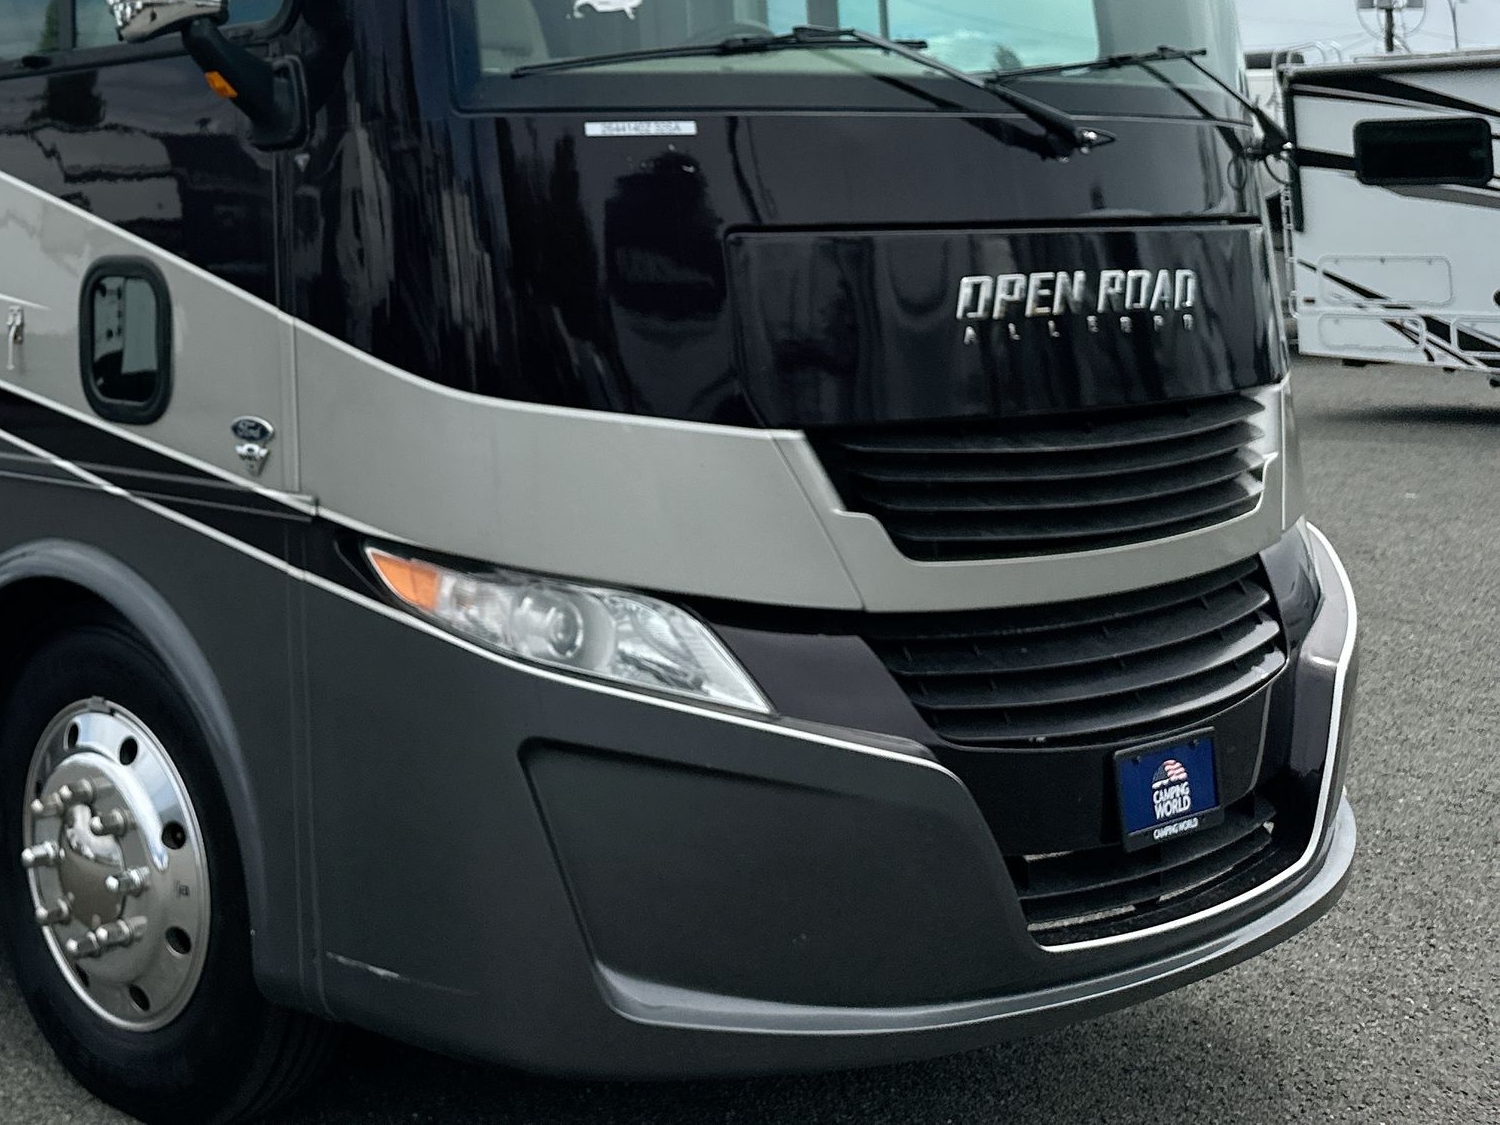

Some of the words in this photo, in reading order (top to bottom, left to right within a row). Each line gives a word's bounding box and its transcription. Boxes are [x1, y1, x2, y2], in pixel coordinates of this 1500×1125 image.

[956, 270, 1087, 320] OPEN
[1097, 269, 1197, 313] ROAD
[1153, 781, 1190, 804] CAMPING
[1154, 795, 1191, 820] WORLD
[1153, 823, 1179, 840] CAMPING
[1179, 817, 1199, 832] WORLD
